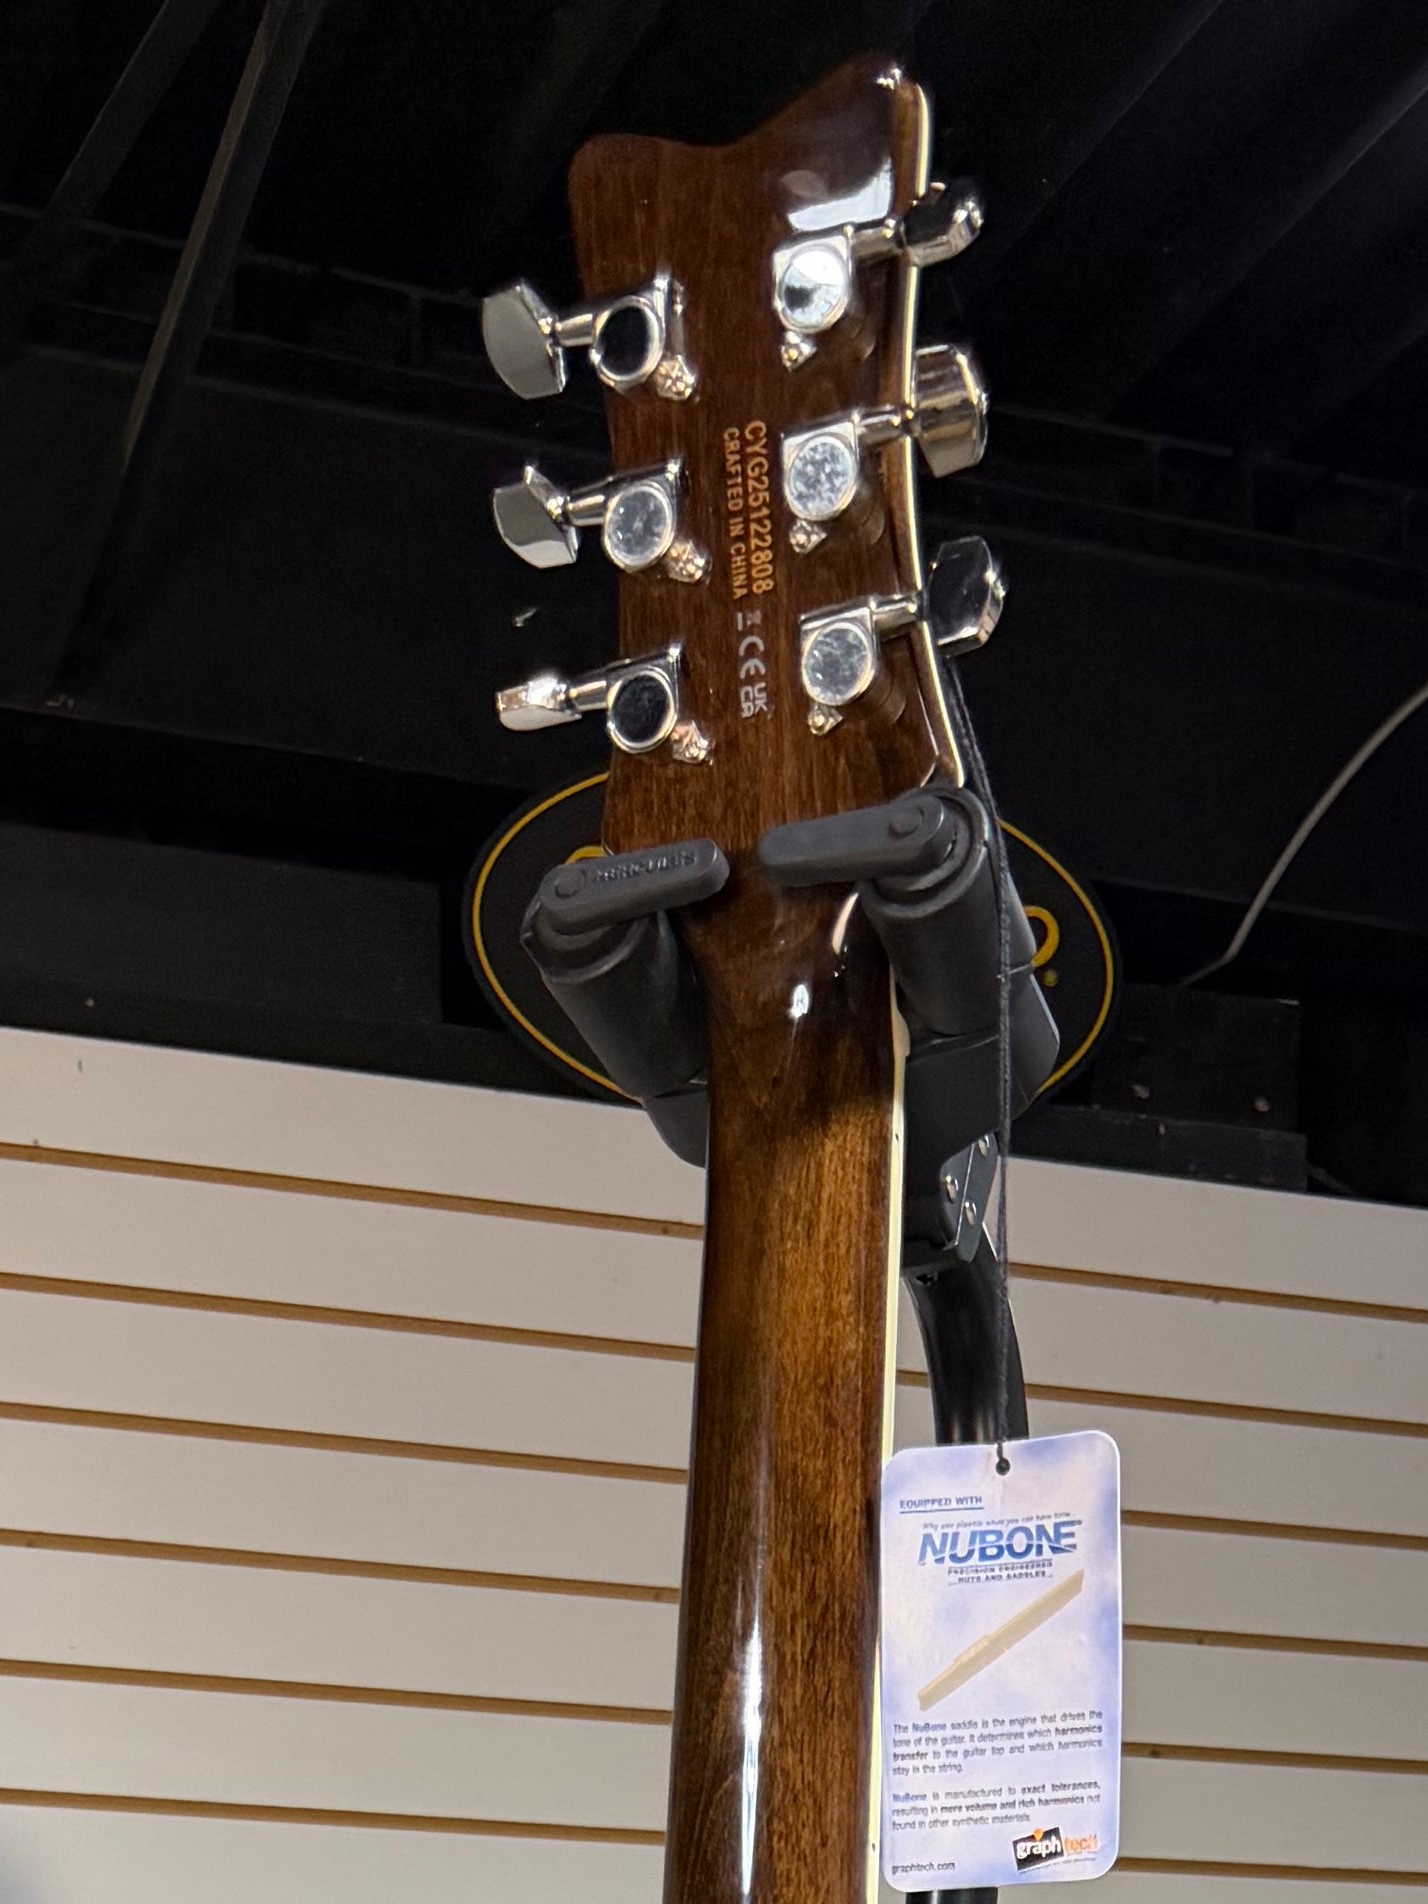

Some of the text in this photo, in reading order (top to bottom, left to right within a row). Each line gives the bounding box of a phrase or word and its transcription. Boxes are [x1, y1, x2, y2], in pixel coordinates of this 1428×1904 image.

[723, 427, 748, 599] CRAFTED IN CHINA
[744, 421, 773, 594] CYG25122808
[899, 1496, 983, 1509] EQUIPPED WITH
[918, 1520, 1077, 1566] NUBONE
[1009, 1716, 1037, 1727] engine
[1041, 1714, 1056, 1724] that
[1027, 1728, 1051, 1739] which
[1016, 1834, 1097, 1858] graph tech
